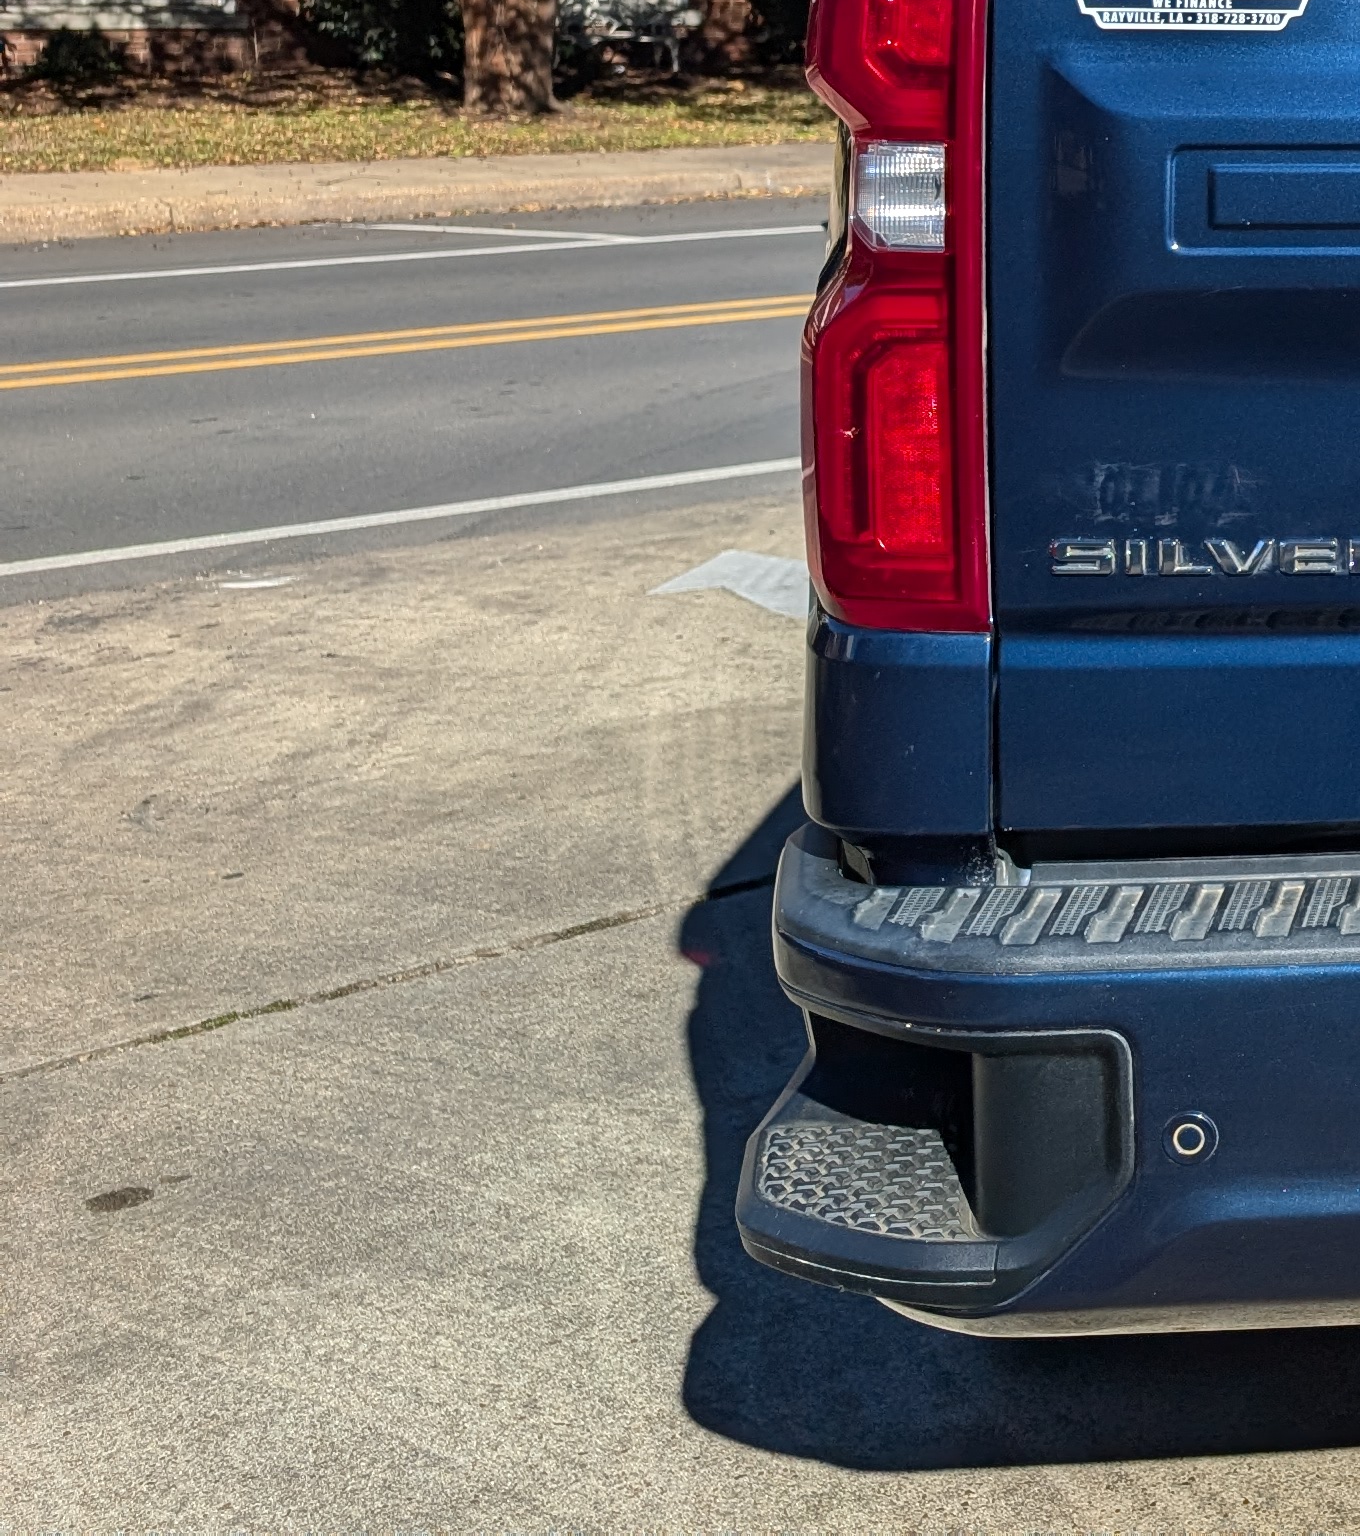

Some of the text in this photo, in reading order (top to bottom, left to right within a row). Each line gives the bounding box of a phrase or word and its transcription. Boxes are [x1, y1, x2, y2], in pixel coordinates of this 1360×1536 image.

[1102, 11, 1281, 25] RAYVILLE, LA 318-728-3700
